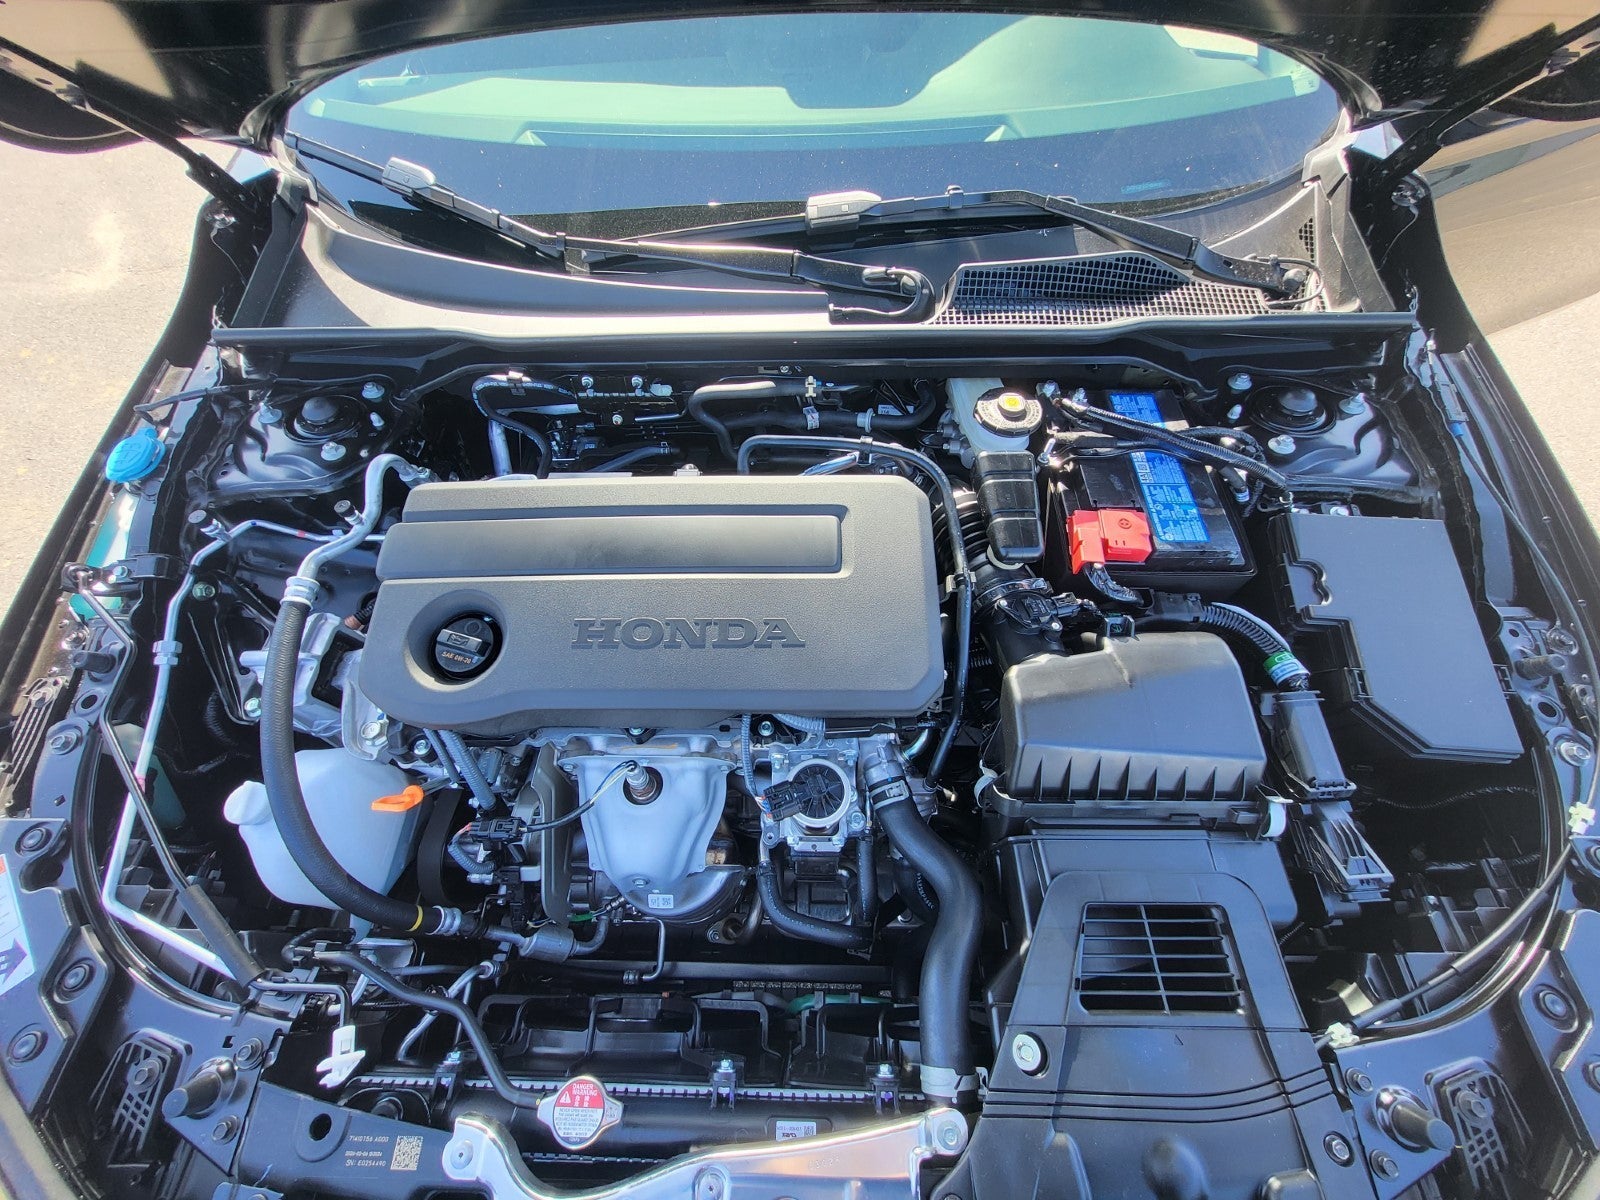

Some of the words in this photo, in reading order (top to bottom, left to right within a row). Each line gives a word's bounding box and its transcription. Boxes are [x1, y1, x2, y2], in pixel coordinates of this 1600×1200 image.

[571, 617, 806, 649] HONDA
[441, 651, 454, 660] SAE
[454, 654, 472, 665] 0W-20
